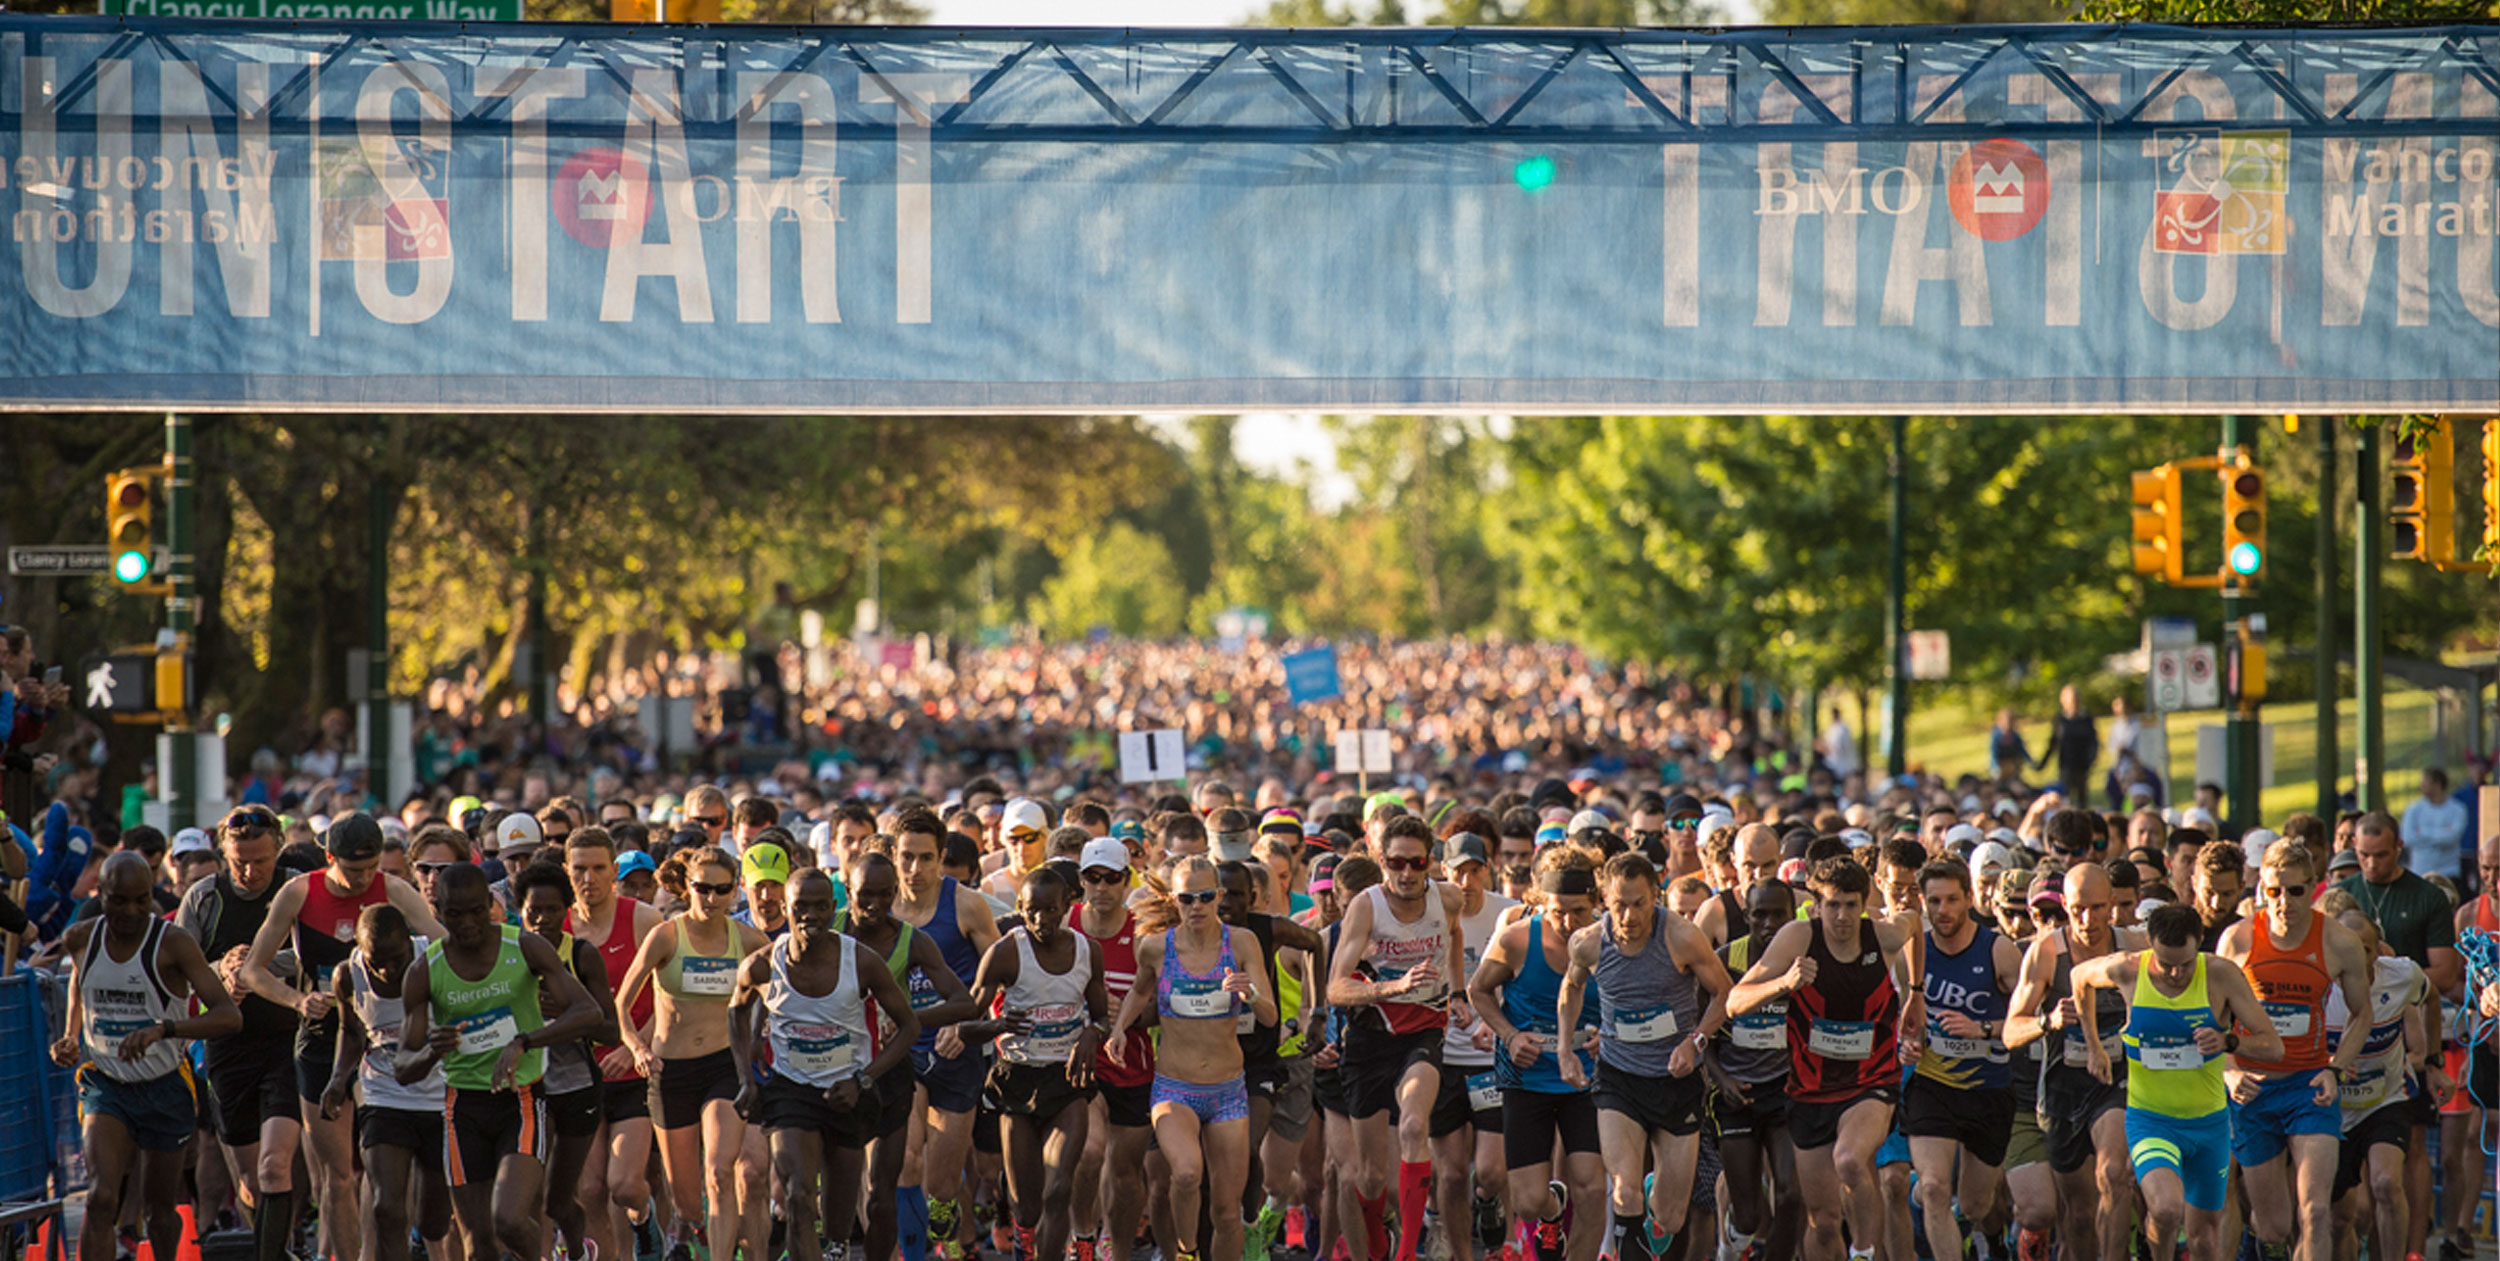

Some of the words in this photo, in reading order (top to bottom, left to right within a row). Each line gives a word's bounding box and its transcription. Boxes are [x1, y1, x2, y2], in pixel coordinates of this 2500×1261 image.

[354, 61, 940, 325] START
[1753, 166, 1922, 215] BMO
[2327, 194, 2500, 237] Marat
[1191, 999, 1210, 1007] LISA
[1923, 973, 1991, 1014] UBC
[1944, 1041, 1976, 1051] 10251
